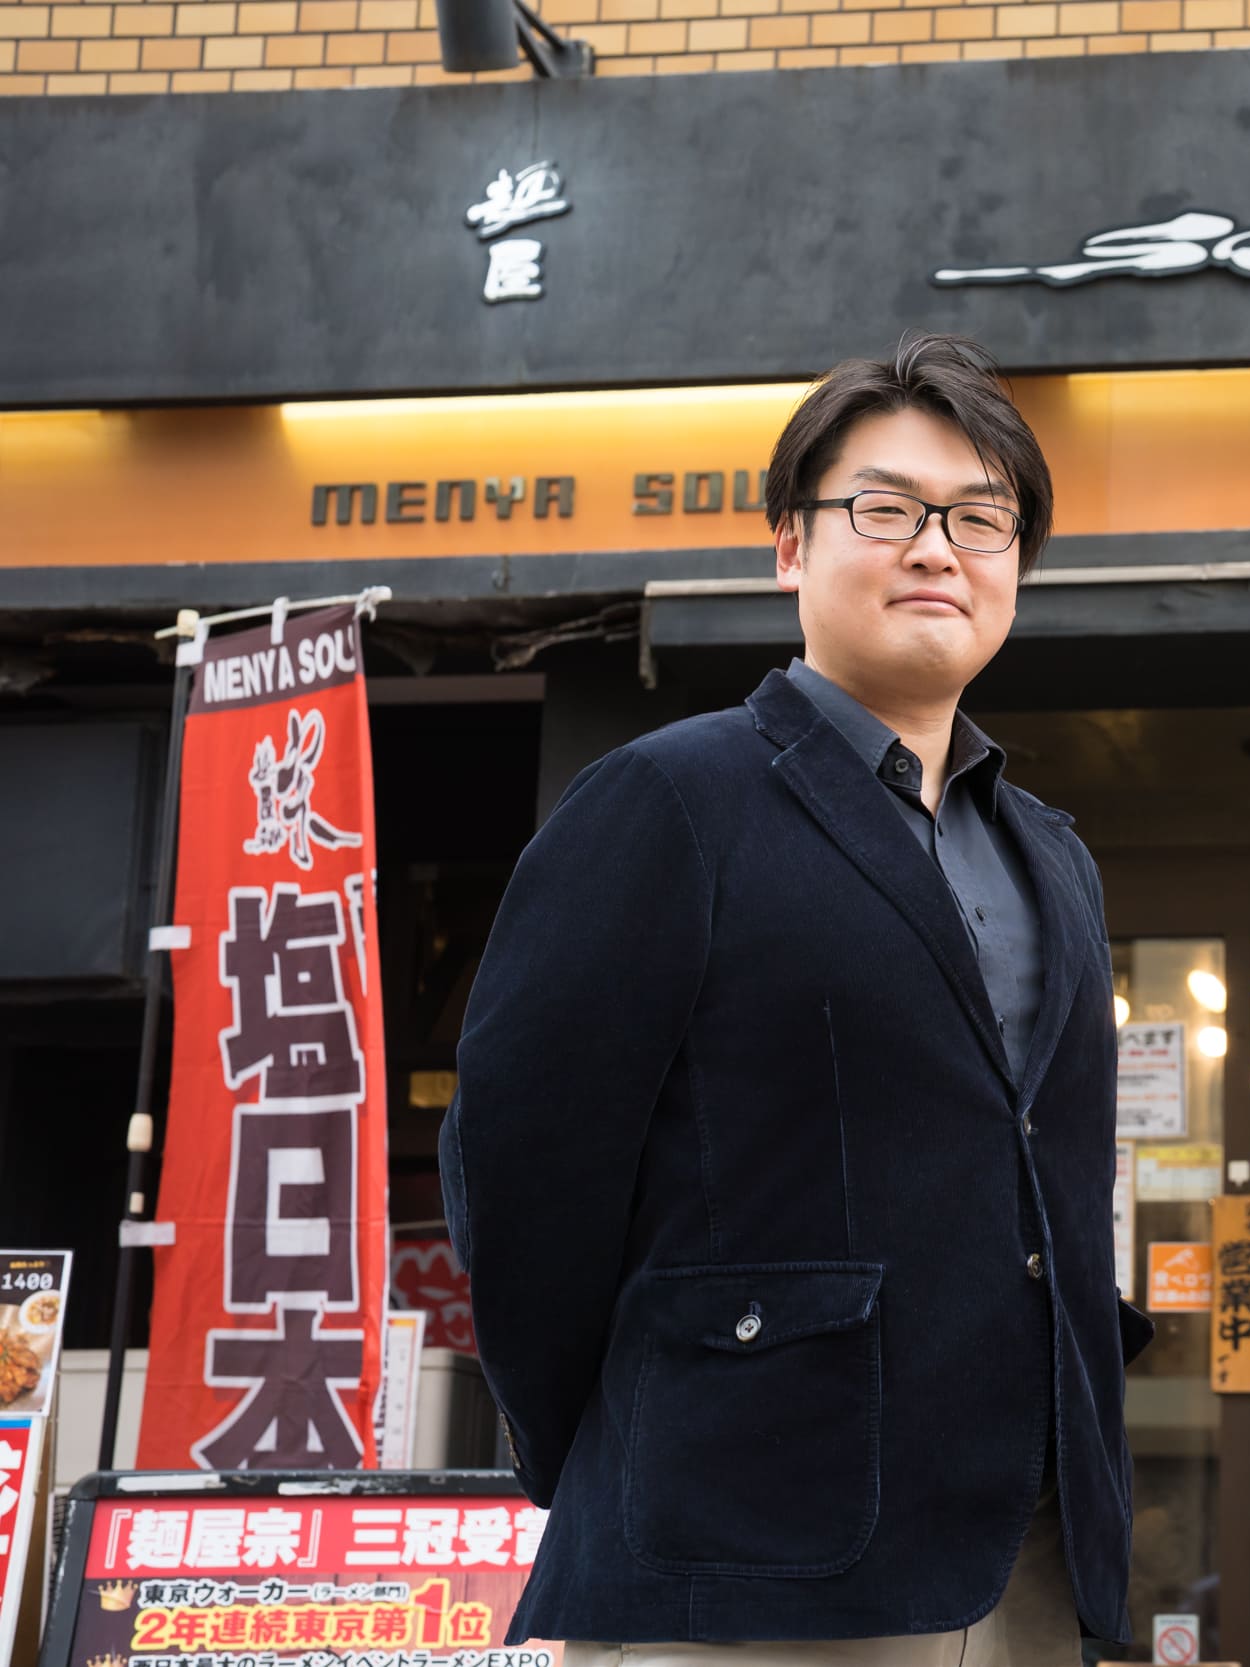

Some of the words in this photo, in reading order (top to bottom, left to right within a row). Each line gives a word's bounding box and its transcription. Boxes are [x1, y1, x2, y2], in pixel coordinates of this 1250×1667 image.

[311, 477, 575, 526] MENYA
[632, 470, 767, 516] SOU
[204, 645, 296, 702] MENYA
[298, 625, 356, 684] SOU
[1, 1272, 54, 1290] 1400
